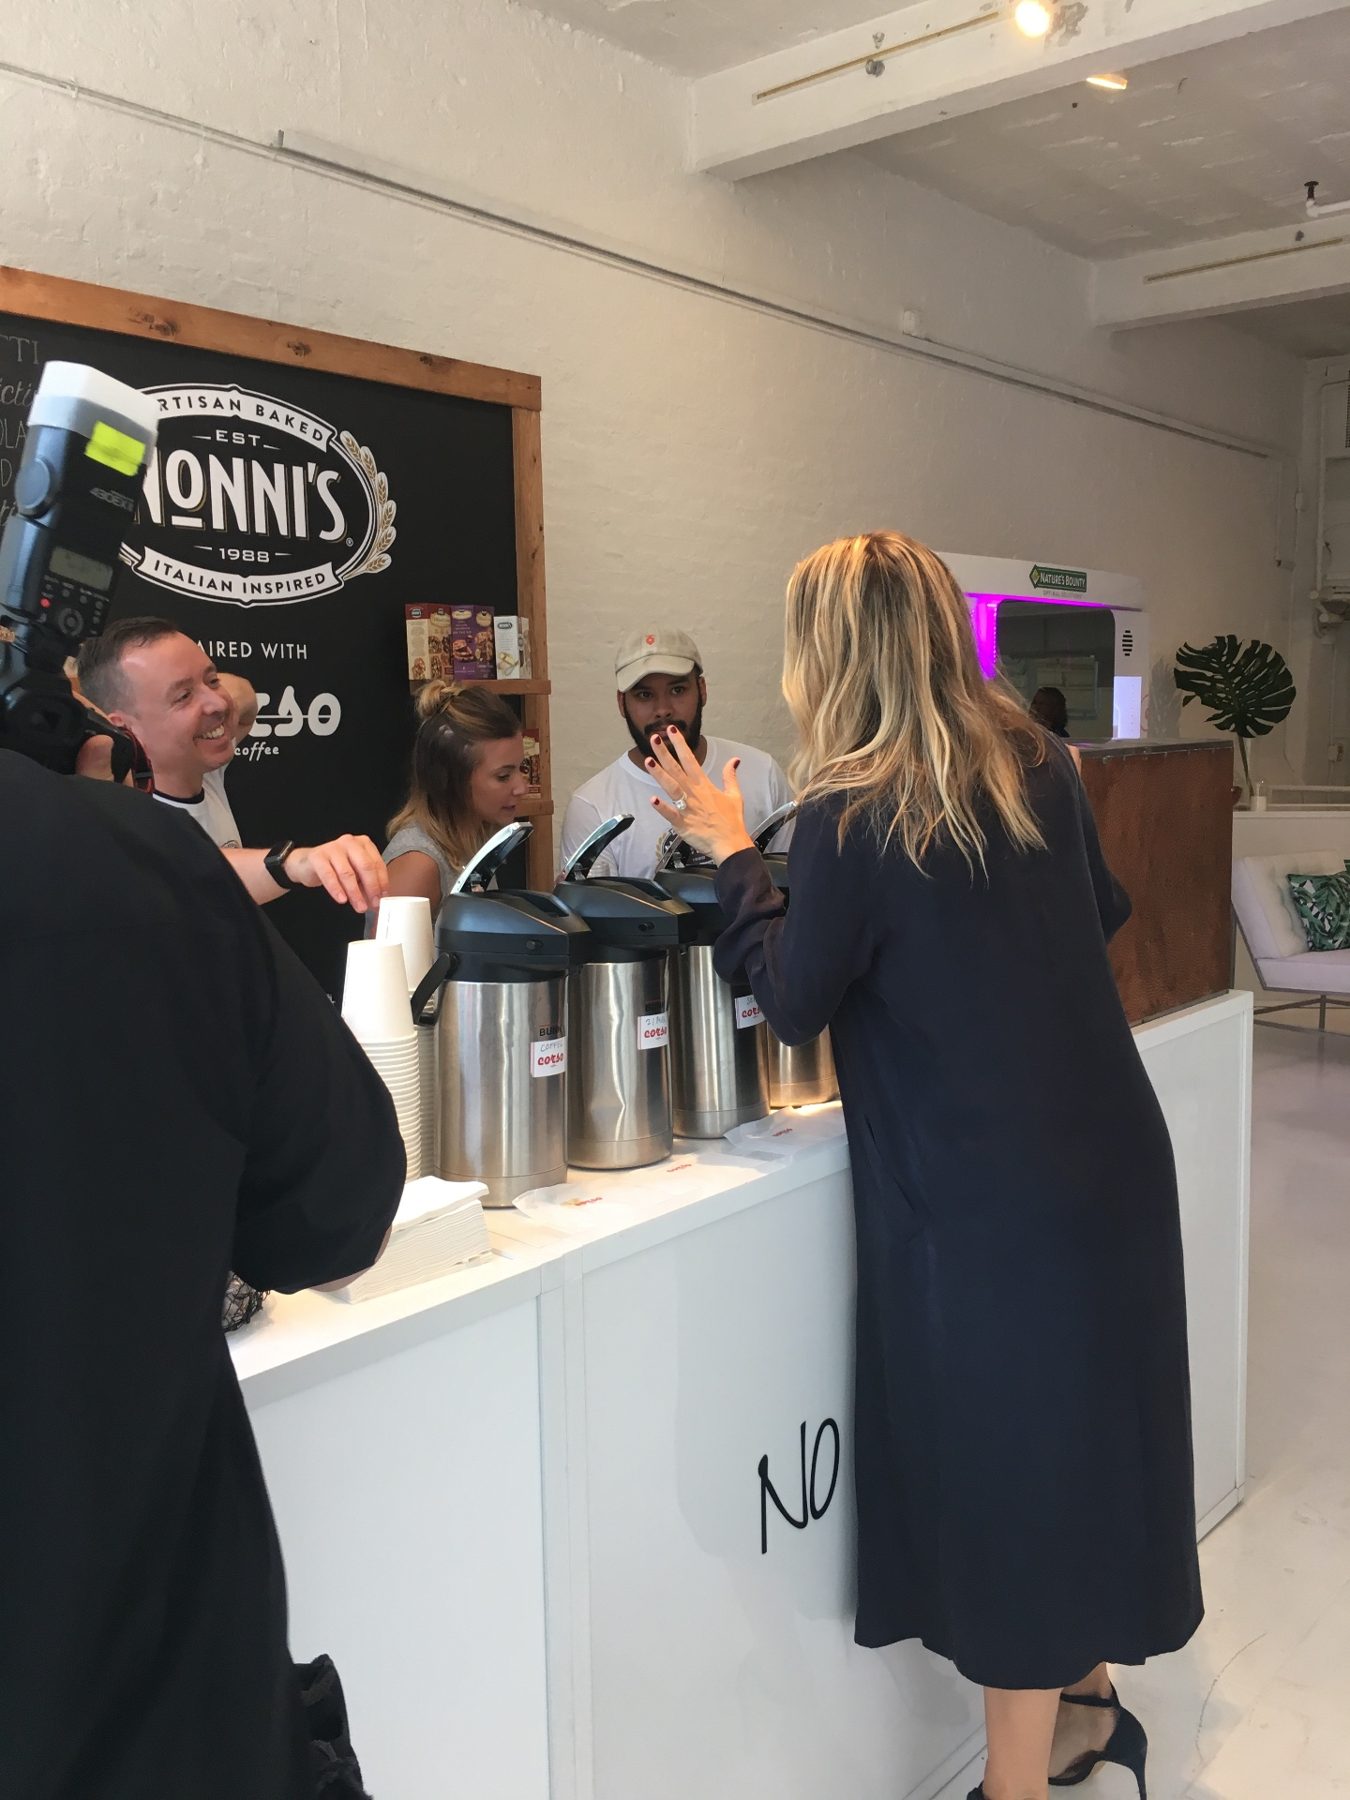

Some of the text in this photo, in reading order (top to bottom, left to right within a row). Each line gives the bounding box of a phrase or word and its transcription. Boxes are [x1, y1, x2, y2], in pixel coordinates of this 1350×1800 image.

[157, 395, 323, 441] RTISAN BAKED
[216, 429, 261, 447] EST
[219, 547, 270, 563] 1988
[154, 559, 326, 595] ITALIAN INSPIRED
[1066, 575, 1085, 587] BOUNTY
[197, 640, 308, 659] AIRED WITH
[234, 741, 280, 762] coffee
[757, 1417, 841, 1555] NO
